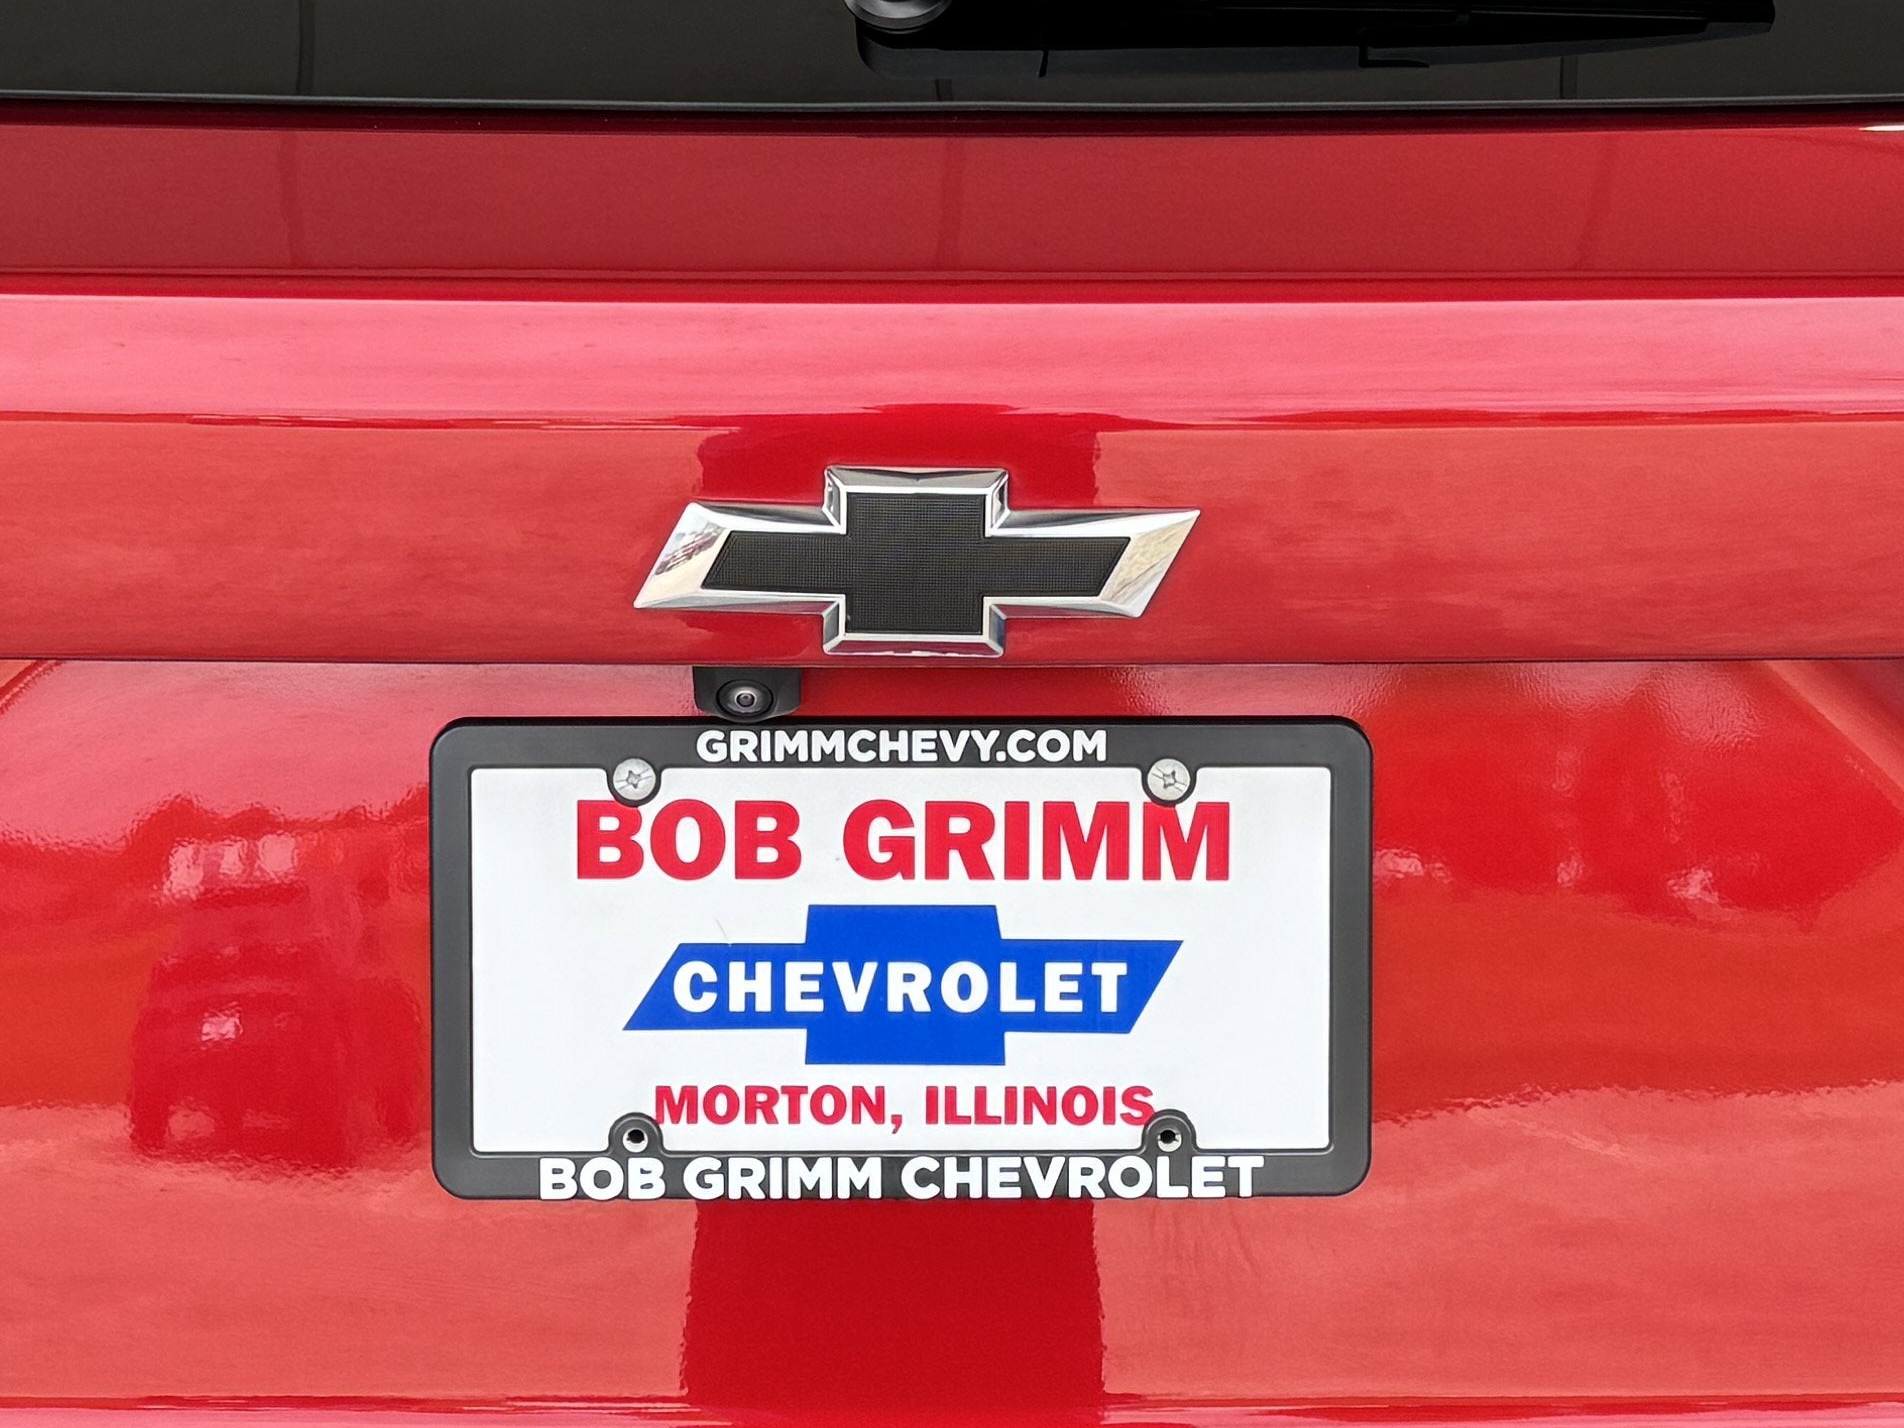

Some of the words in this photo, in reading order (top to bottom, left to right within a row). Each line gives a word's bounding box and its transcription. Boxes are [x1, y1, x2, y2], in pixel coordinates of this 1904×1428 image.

[696, 728, 1108, 764] GRIMMCHEVY.COM
[576, 799, 803, 881] BOB
[842, 799, 1230, 881] GRIMM
[672, 960, 1129, 1014] CHEVROLET
[654, 1083, 904, 1135] MORTON,
[925, 1084, 1155, 1127] ILLINOIS
[539, 1156, 666, 1200] BOB
[683, 1156, 882, 1200] GRIMM
[900, 1155, 1265, 1200] CHEVROLET
